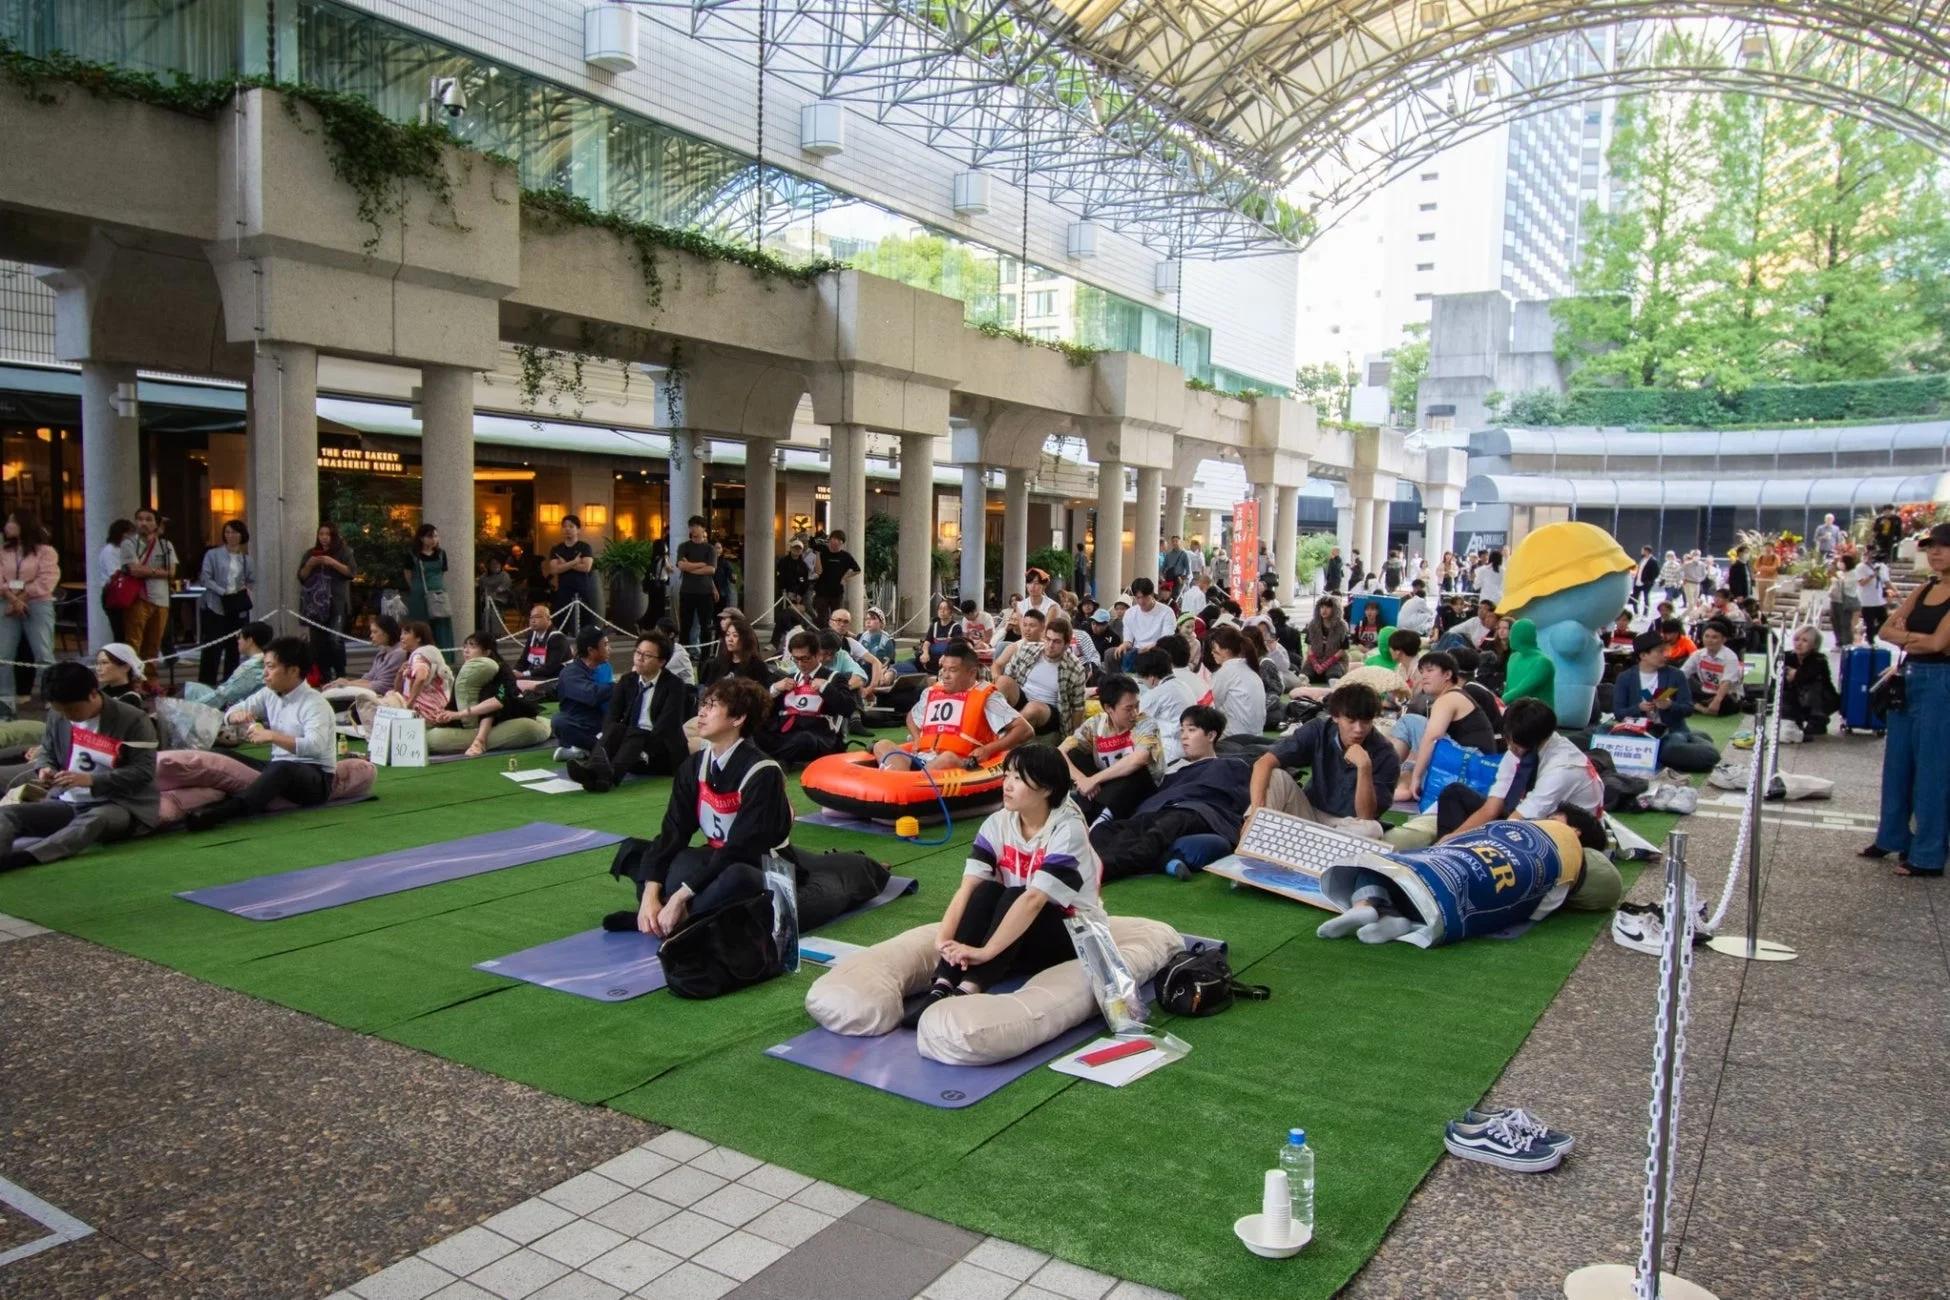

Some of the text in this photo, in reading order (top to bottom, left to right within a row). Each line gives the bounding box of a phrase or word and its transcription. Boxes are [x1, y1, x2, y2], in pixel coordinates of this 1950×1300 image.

[321, 447, 399, 461] THE CITY BAKERY
[317, 458, 403, 472] BRASSERIE RUBIN
[1362, 632, 1375, 641] 40
[930, 702, 954, 722] 10
[78, 751, 97, 772] 3
[1613, 751, 1643, 760] 用協会
[712, 814, 726, 841] 5
[1471, 847, 1516, 895] ER
